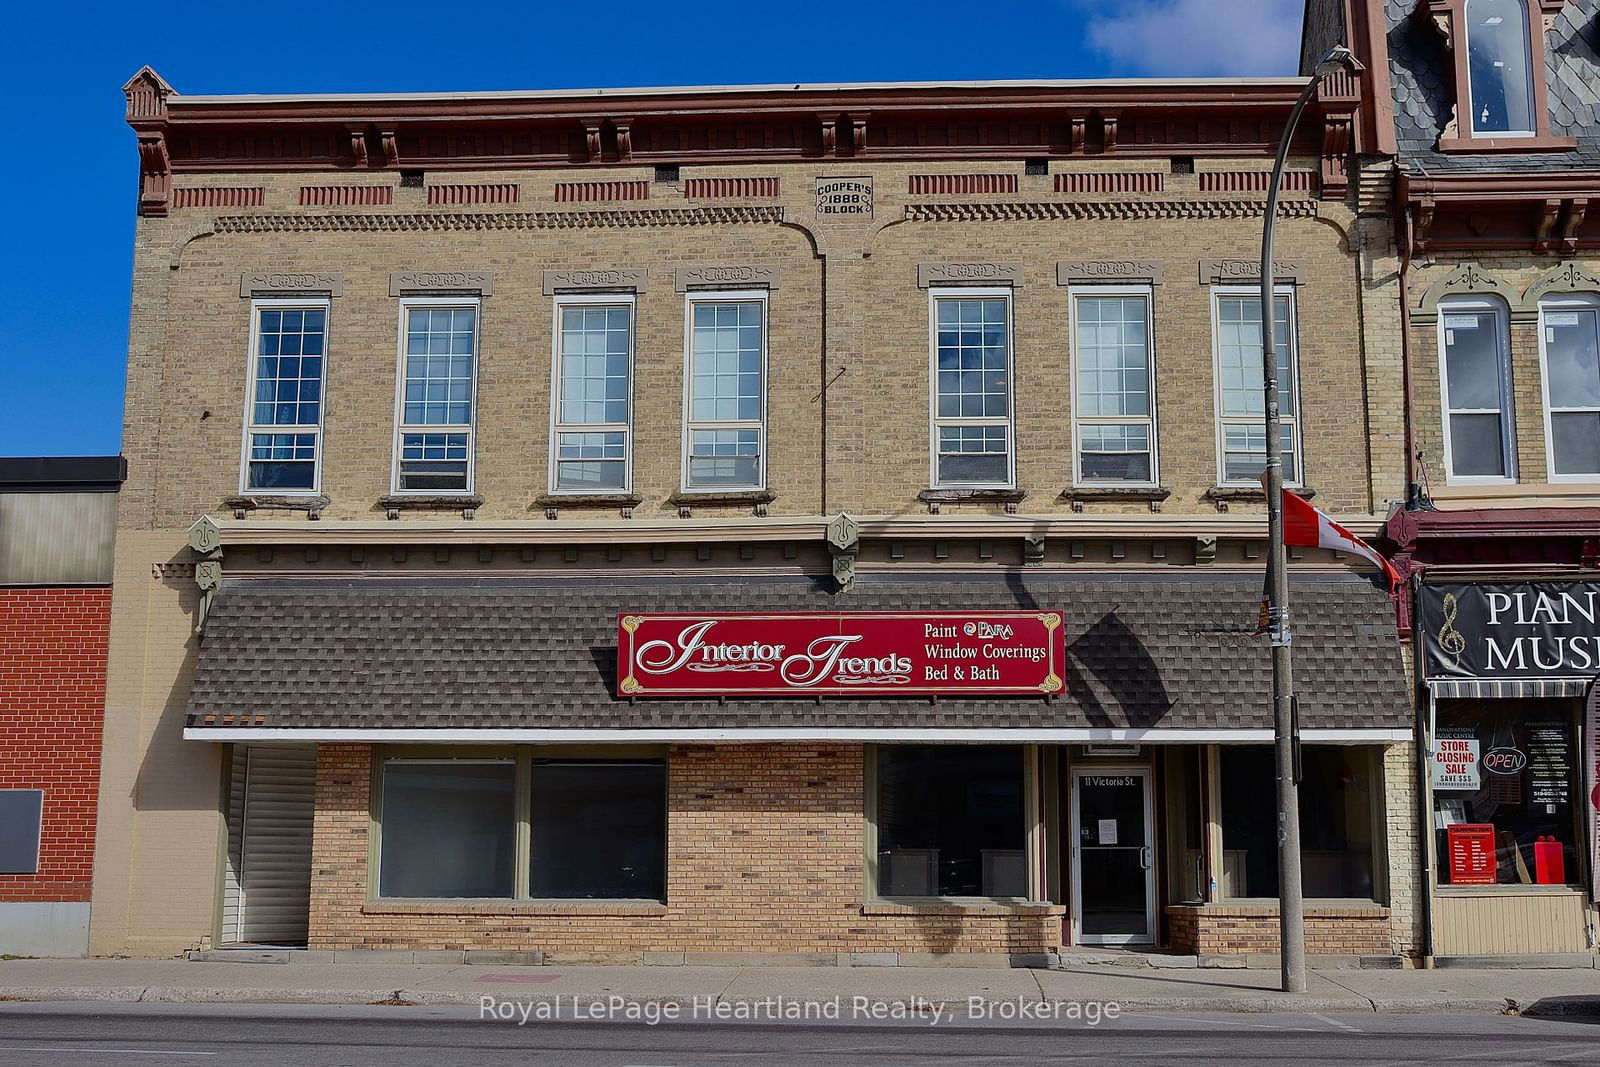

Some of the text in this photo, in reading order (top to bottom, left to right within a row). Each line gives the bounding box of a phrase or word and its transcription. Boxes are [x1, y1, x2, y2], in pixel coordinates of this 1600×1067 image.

[817, 182, 871, 195] COOPER'S
[829, 194, 860, 204] 1888
[824, 205, 864, 214] BLOCK
[1484, 592, 1597, 625] PIAN
[924, 621, 1014, 640] Paint PARA
[636, 620, 913, 688] Interior Trends
[924, 642, 1046, 663] Window Coverings
[924, 664, 1000, 681] Bed & Bath
[1441, 741, 1469, 751] STORE
[1436, 752, 1475, 762] CLOSING
[1486, 754, 1522, 768] OPEN
[1445, 764, 1466, 774] SALE
[1092, 777, 1124, 787] Victoria
